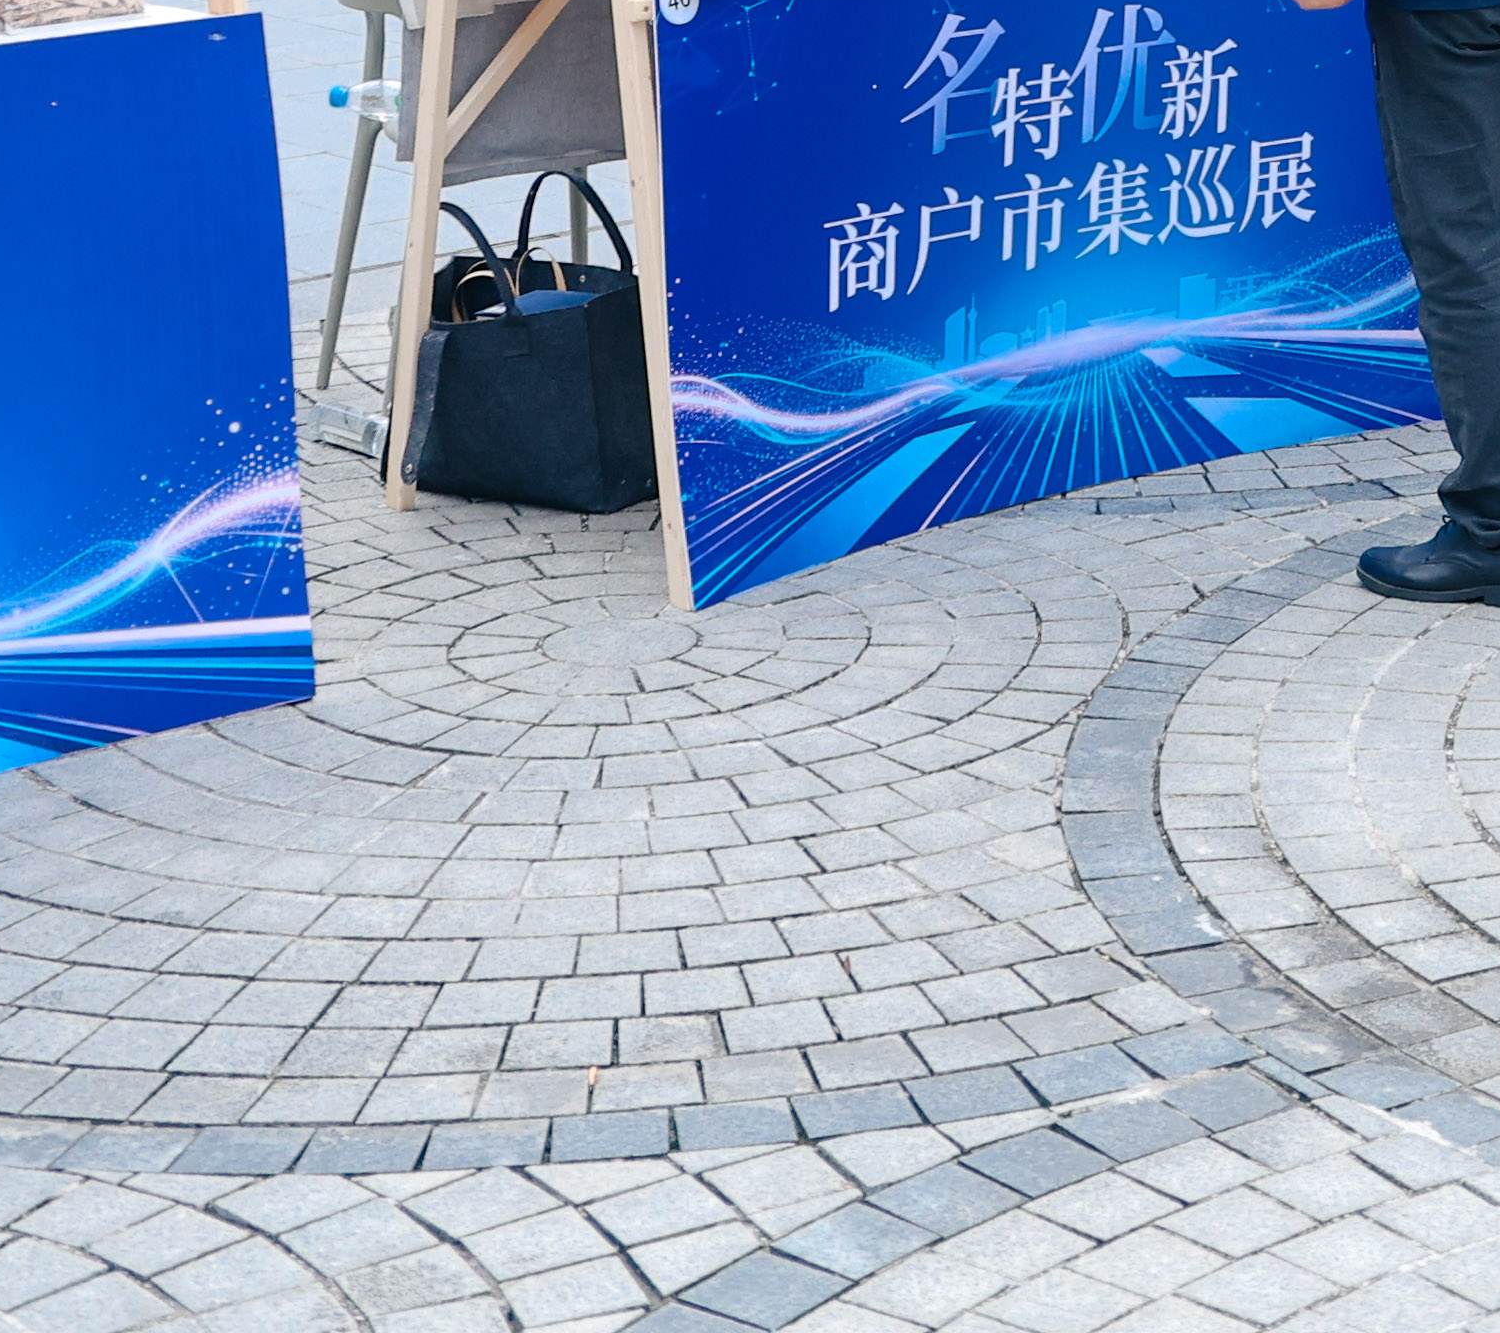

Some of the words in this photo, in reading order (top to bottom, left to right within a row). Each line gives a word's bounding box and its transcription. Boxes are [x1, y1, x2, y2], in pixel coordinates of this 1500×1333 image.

[900, 3, 1240, 168] 名特优新
[823, 132, 1317, 313] 商户市集巡展
